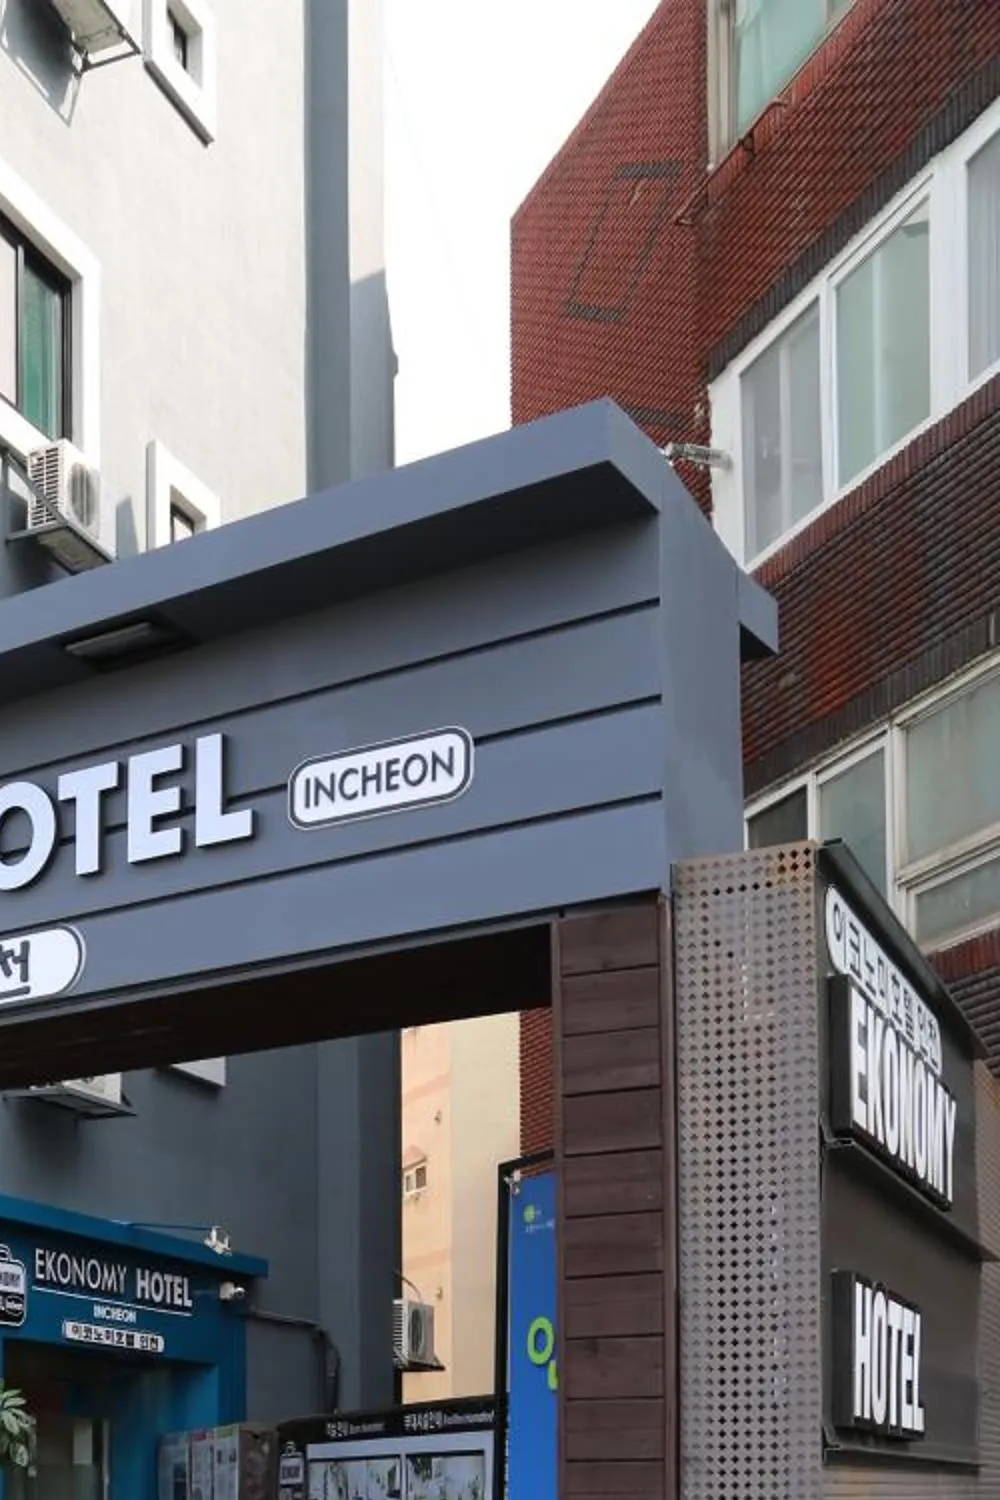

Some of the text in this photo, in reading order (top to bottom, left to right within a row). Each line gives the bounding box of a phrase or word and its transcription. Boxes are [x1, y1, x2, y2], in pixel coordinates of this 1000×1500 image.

[303, 747, 456, 809] INCHEON
[833, 902, 941, 1070] 이코노미호텔 인천
[849, 985, 957, 1202] EKONOMY
[34, 1248, 193, 1308] EKONOMY HOTEL
[93, 1303, 137, 1324] INCHEON
[853, 1280, 925, 1433] HOTEL
